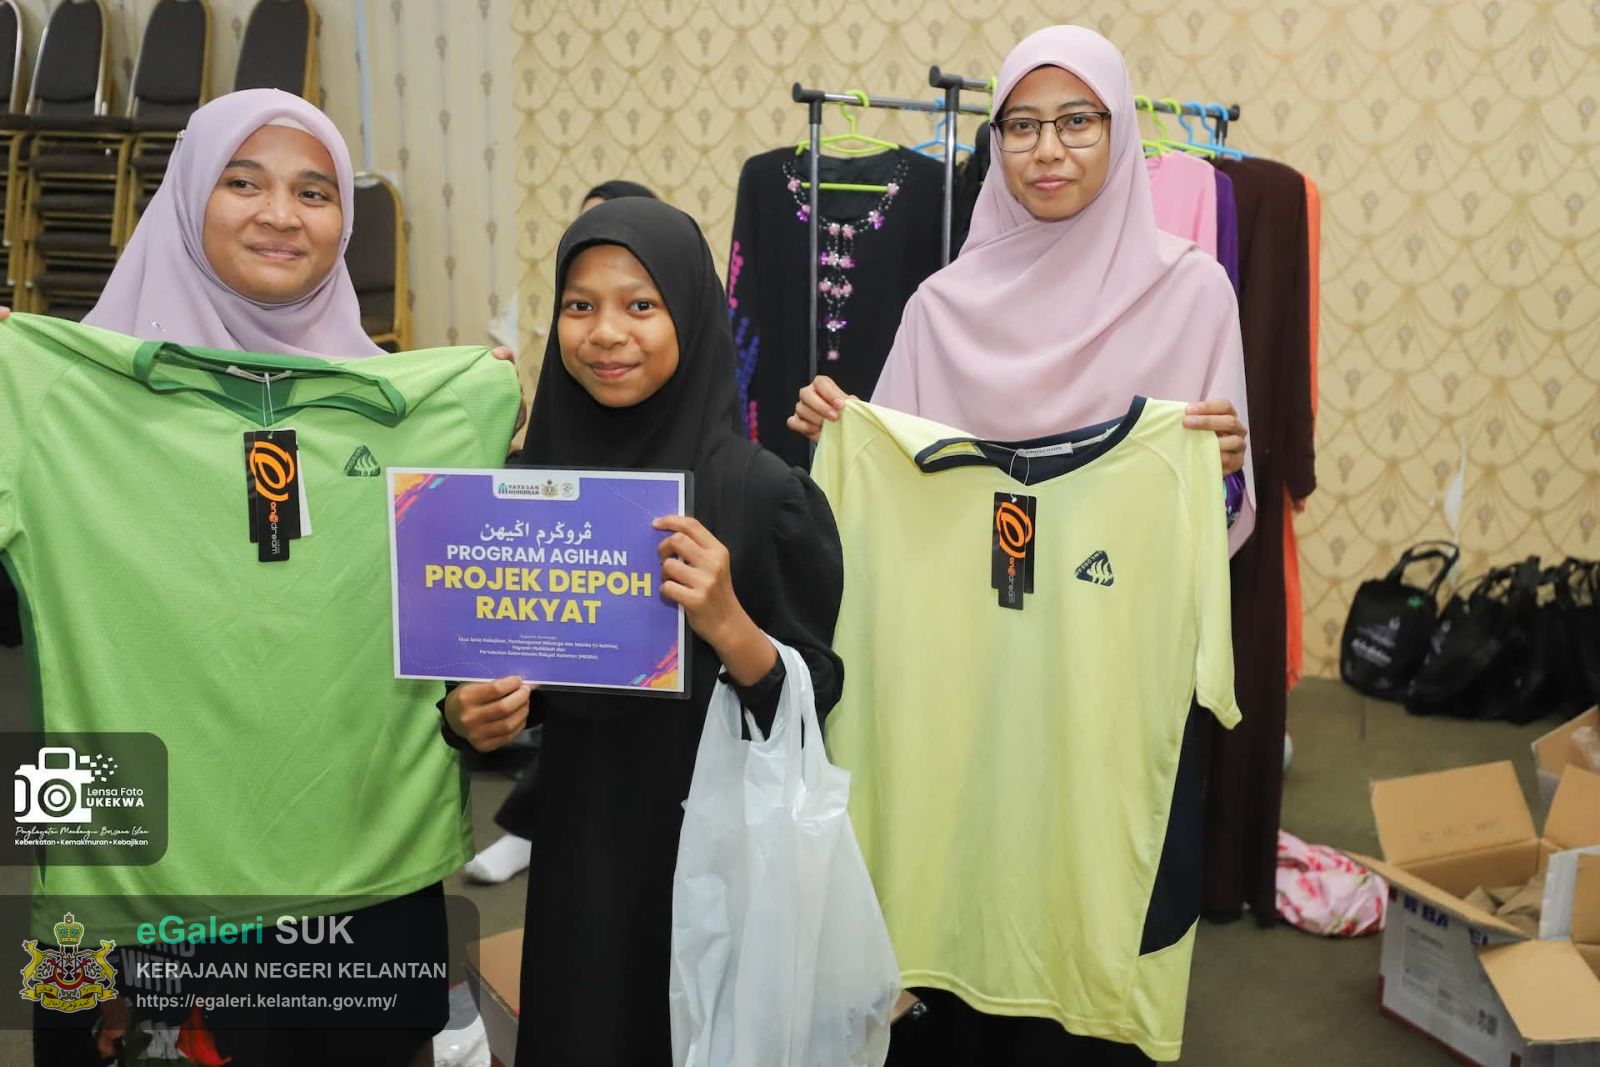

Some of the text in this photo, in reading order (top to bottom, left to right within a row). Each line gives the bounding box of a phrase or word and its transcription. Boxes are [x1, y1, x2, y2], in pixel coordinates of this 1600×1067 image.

[447, 545, 627, 566] PROGRAM AGIHAN
[425, 565, 652, 597] PROJEK DEPOH
[476, 596, 602, 624] RAKYAT
